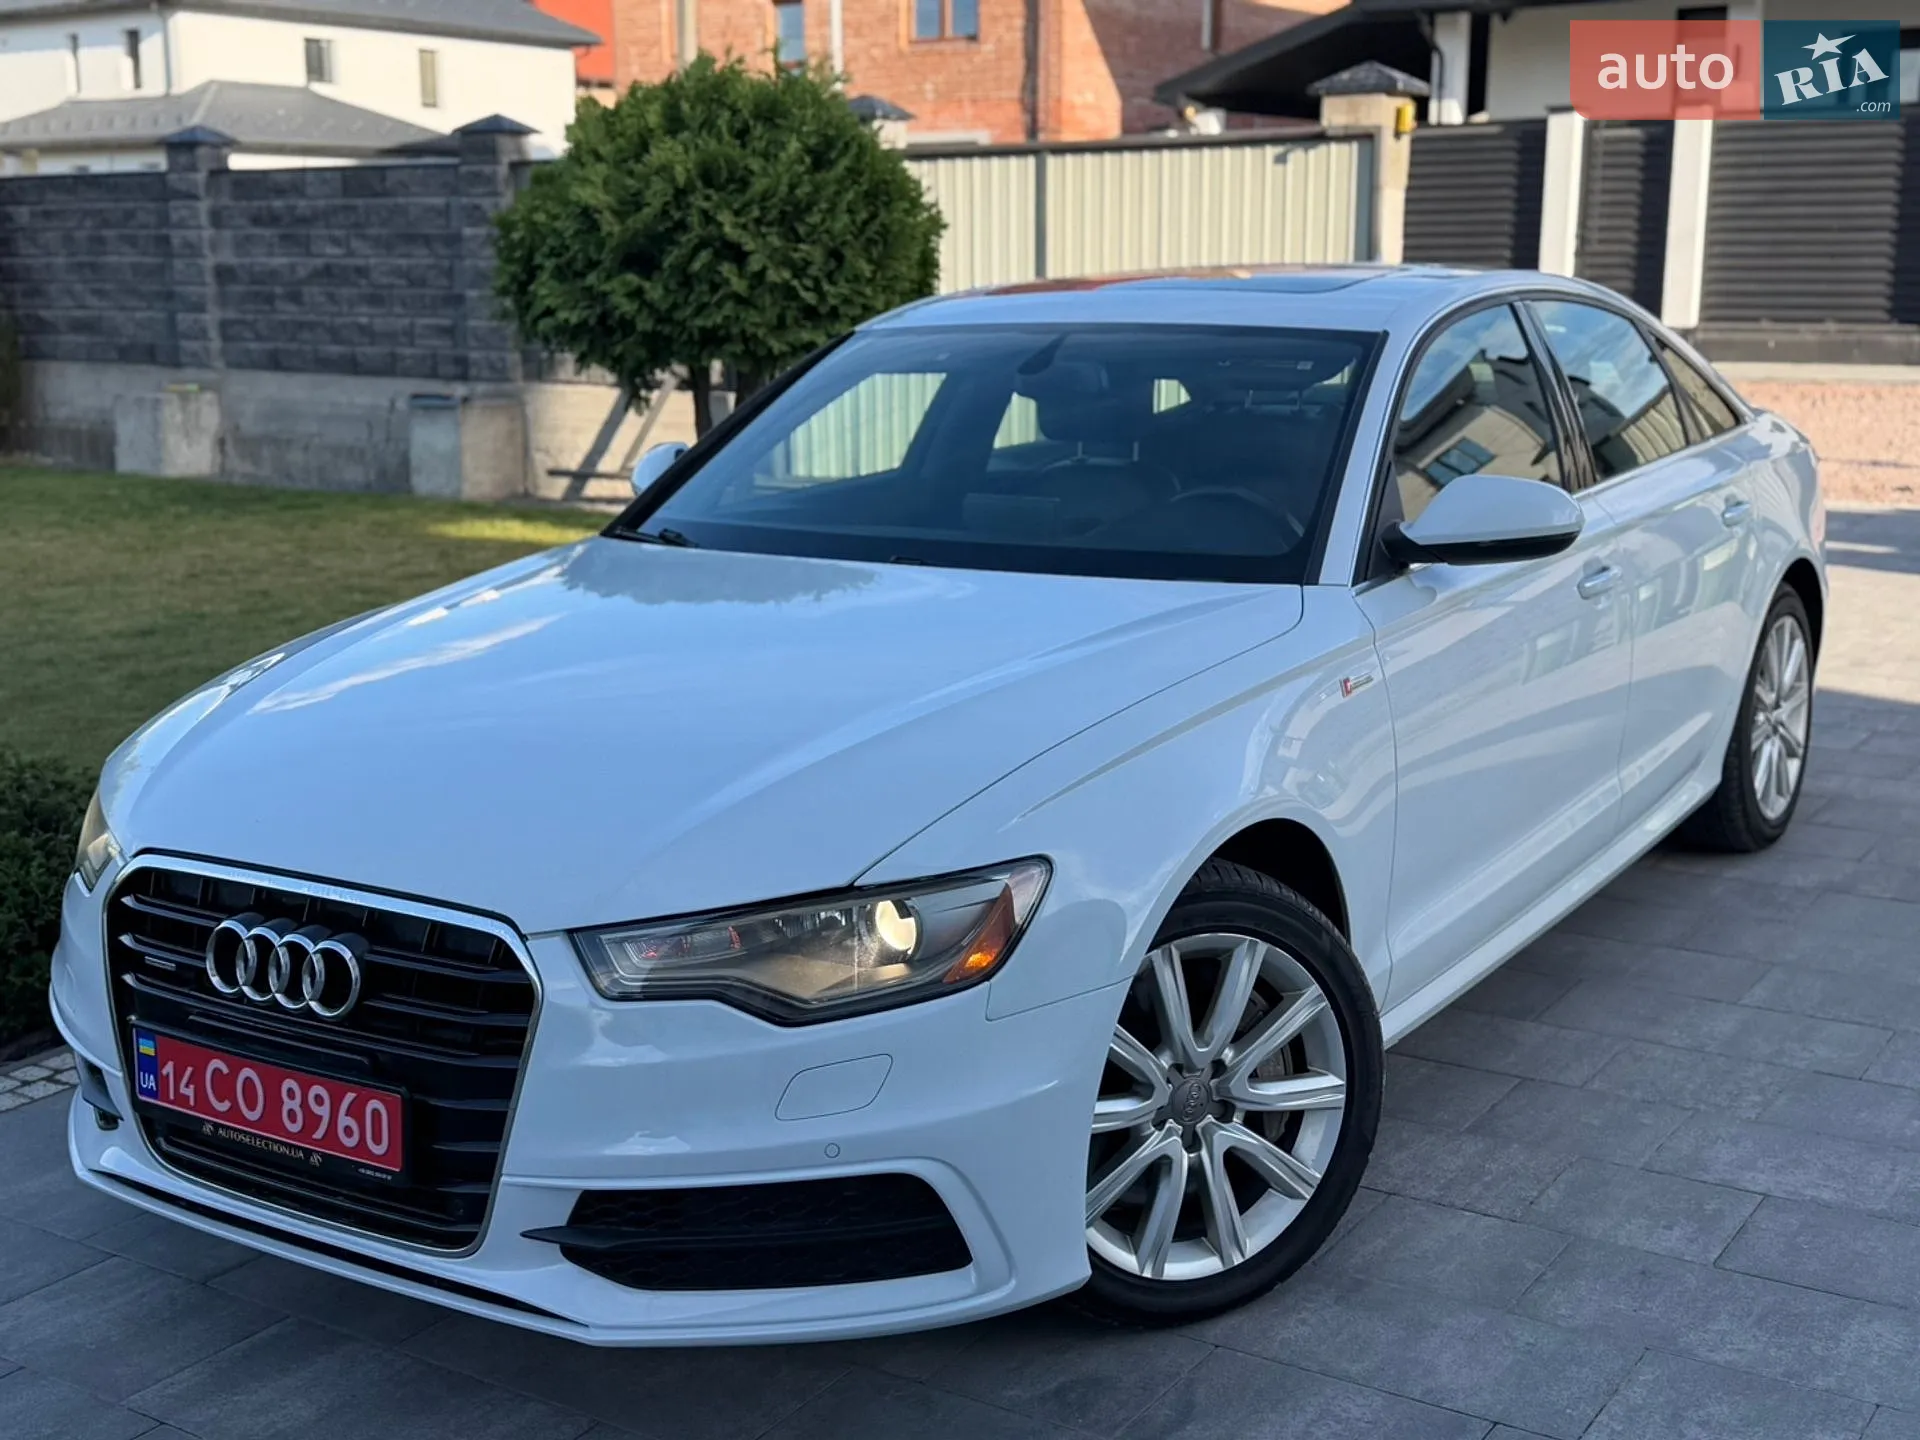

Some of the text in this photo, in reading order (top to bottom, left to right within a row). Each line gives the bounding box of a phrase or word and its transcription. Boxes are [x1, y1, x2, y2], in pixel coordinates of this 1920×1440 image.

[139, 1072, 157, 1092] UA
[280, 1078, 389, 1157] 8960
[217, 1126, 305, 1161] AUTOSELECTION.UA
